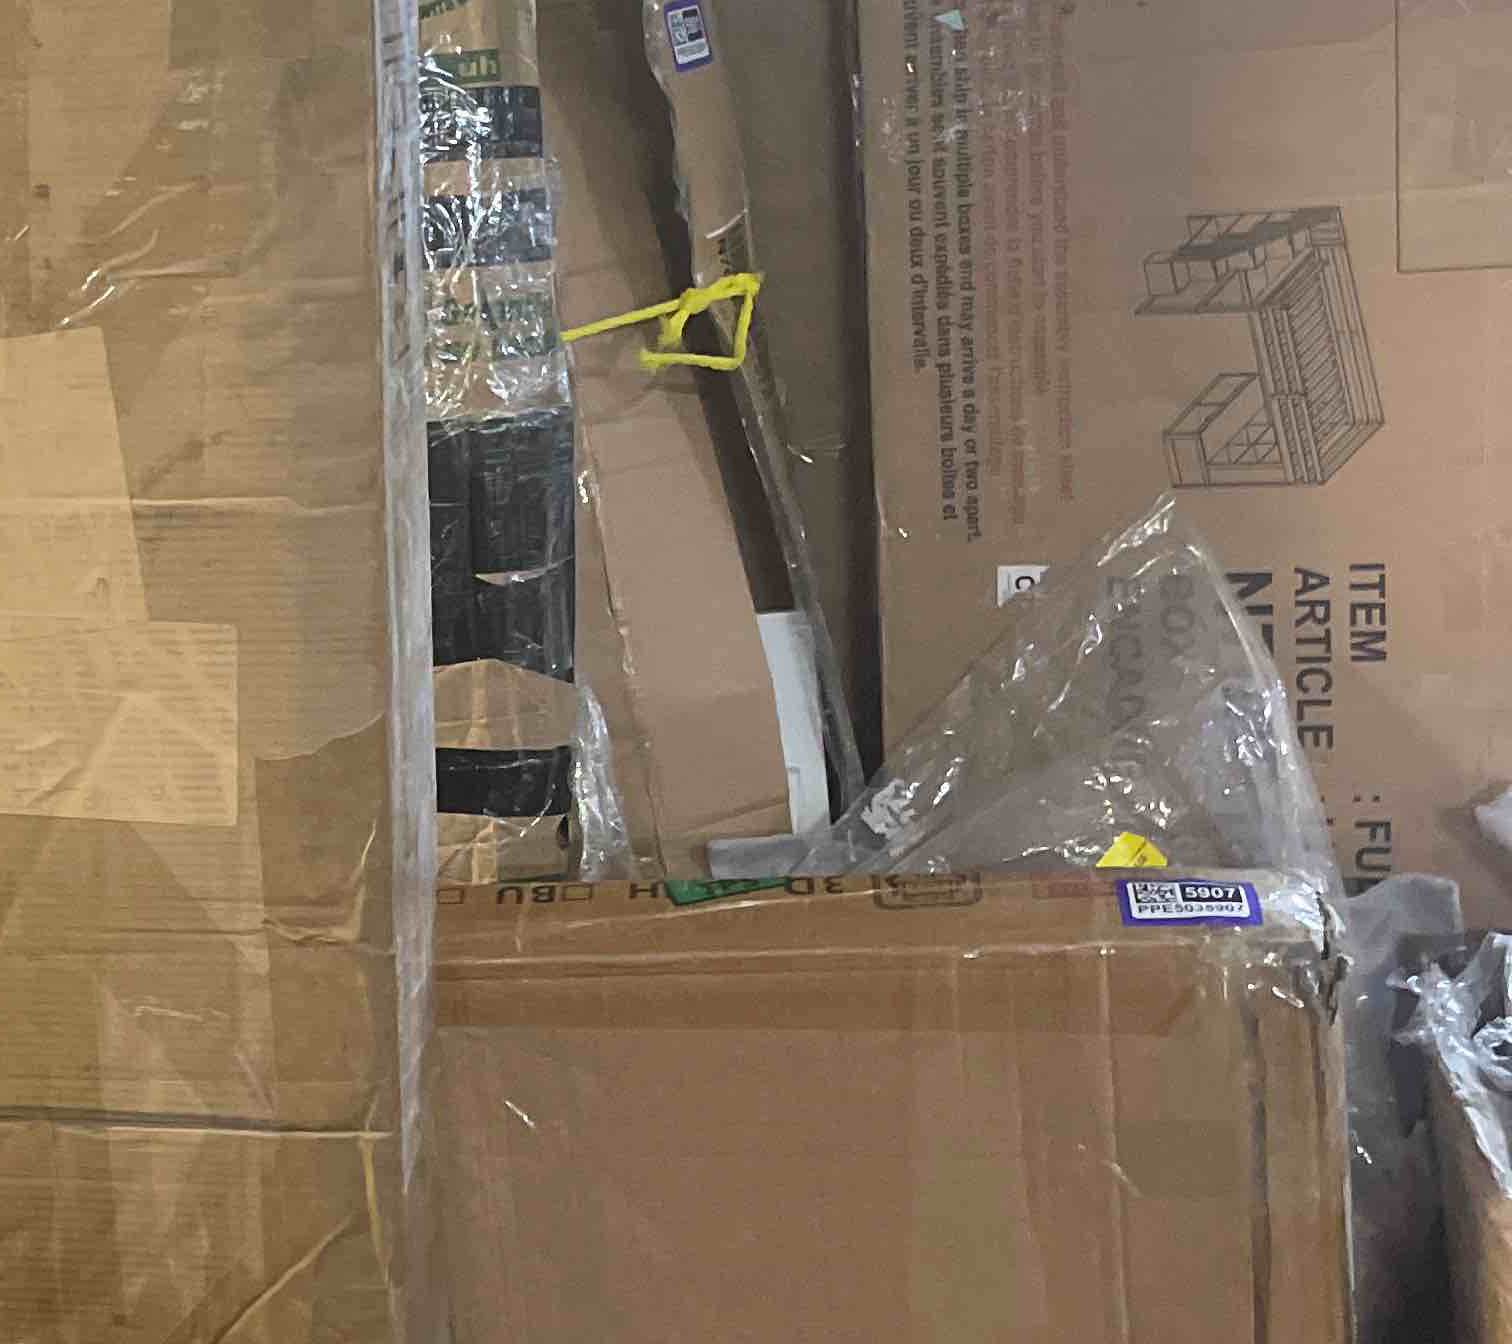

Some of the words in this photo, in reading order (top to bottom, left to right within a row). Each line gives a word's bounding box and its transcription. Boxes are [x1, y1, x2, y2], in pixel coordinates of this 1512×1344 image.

[1292, 566, 1336, 751] ARTICLE
[1348, 562, 1388, 662] ITEM
[1184, 886, 1236, 899] 5907
